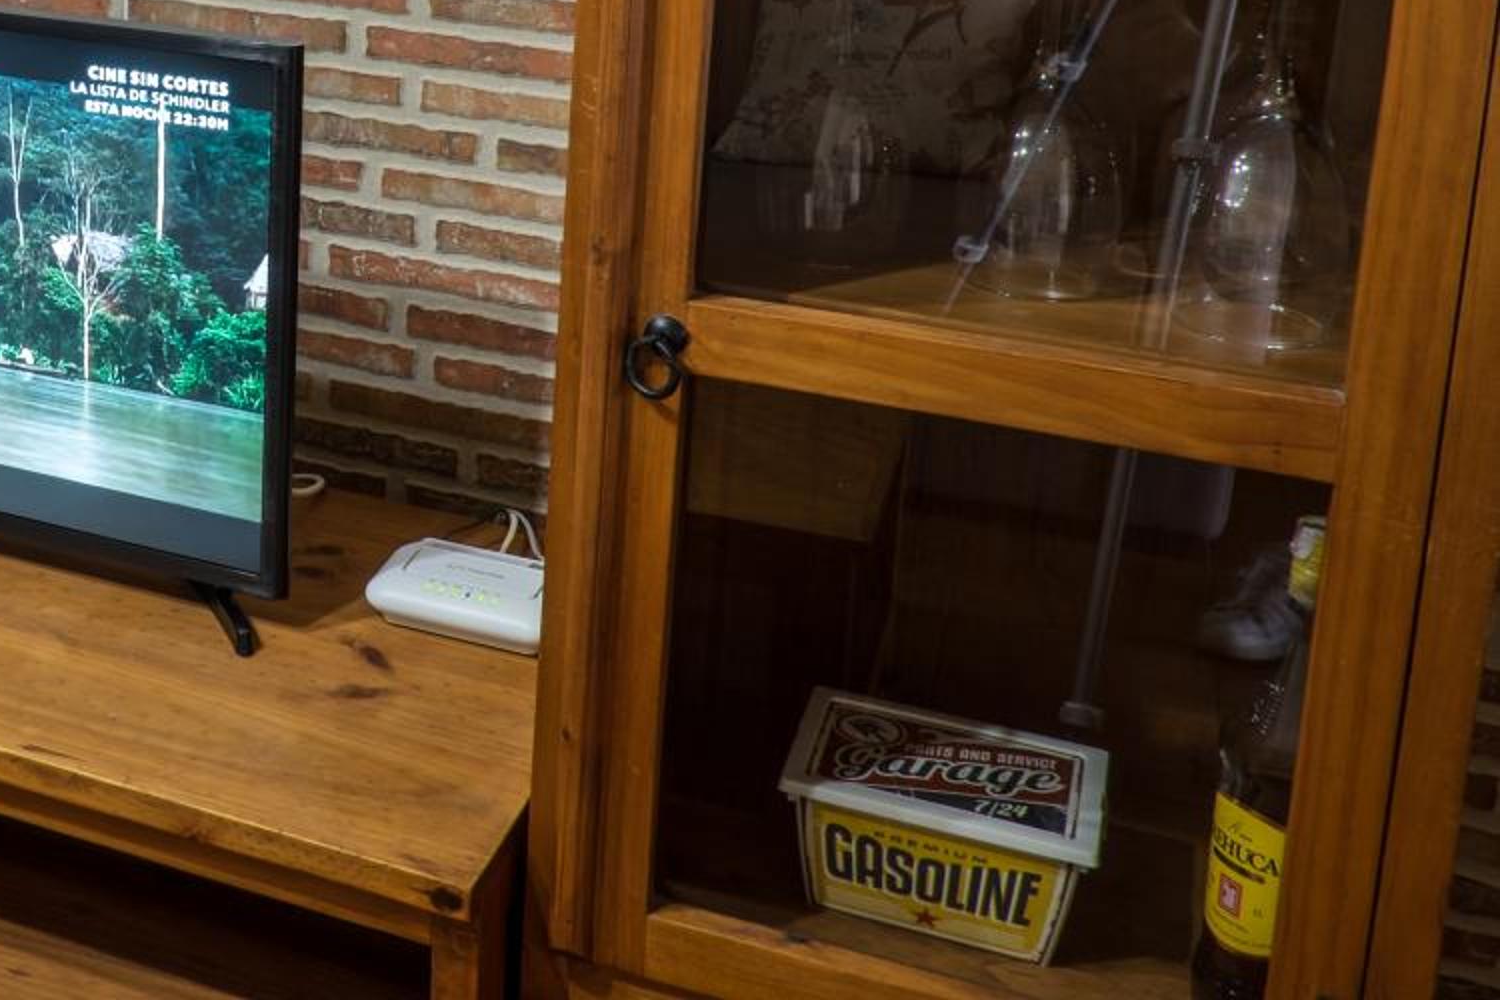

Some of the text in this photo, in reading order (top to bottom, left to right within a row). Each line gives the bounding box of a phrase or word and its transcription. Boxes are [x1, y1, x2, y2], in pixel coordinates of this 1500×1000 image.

[69, 80, 230, 114] LA LISTA DE SCHINDLER
[87, 64, 229, 97] CINE SIN CORTES
[84, 99, 119, 117] ESTA
[835, 742, 1065, 798] Garage
[958, 748, 991, 762] AND
[996, 752, 1057, 770] SERVICE
[824, 822, 1044, 927] GASOLINE
